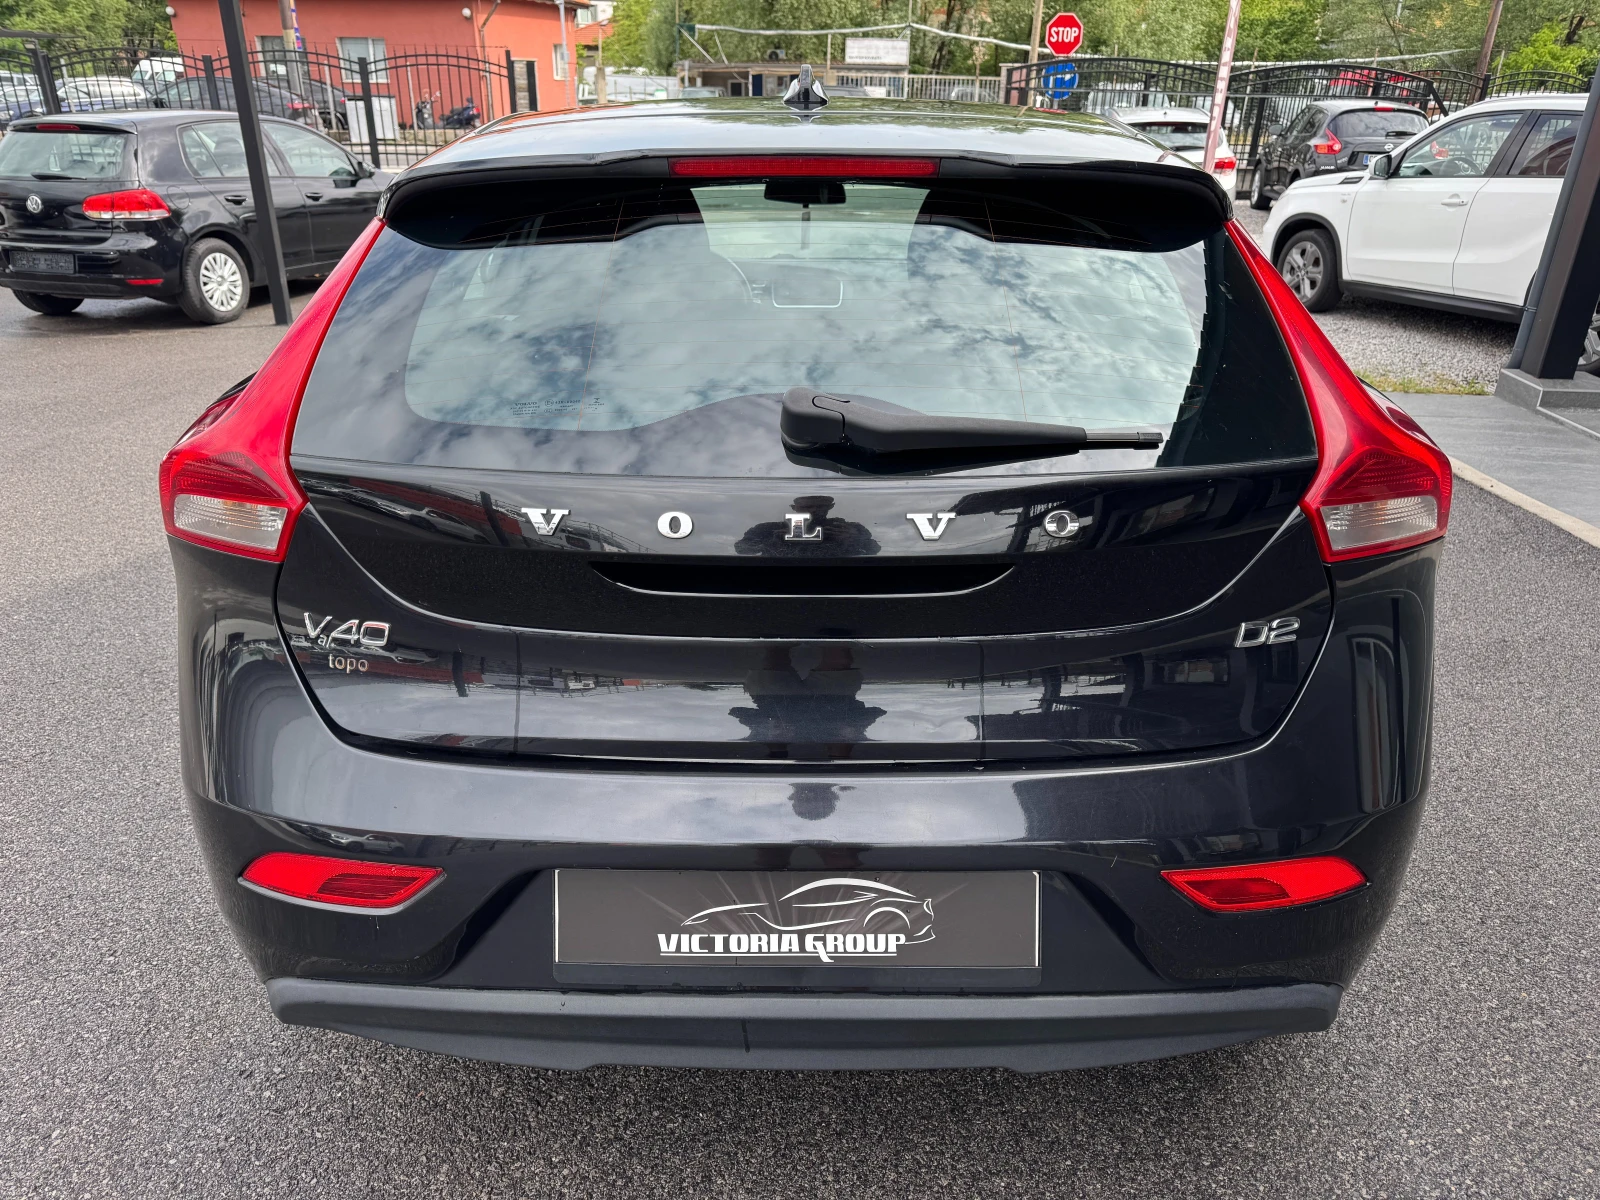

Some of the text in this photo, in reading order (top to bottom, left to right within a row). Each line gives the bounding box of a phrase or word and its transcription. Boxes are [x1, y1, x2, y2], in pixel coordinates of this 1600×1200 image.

[1050, 26, 1080, 43] STOP
[521, 507, 1079, 541] VOLVO
[303, 611, 391, 647] V40
[1234, 616, 1300, 648] D2
[328, 652, 369, 674] topo
[656, 933, 906, 963] VICTORIA GROUP
